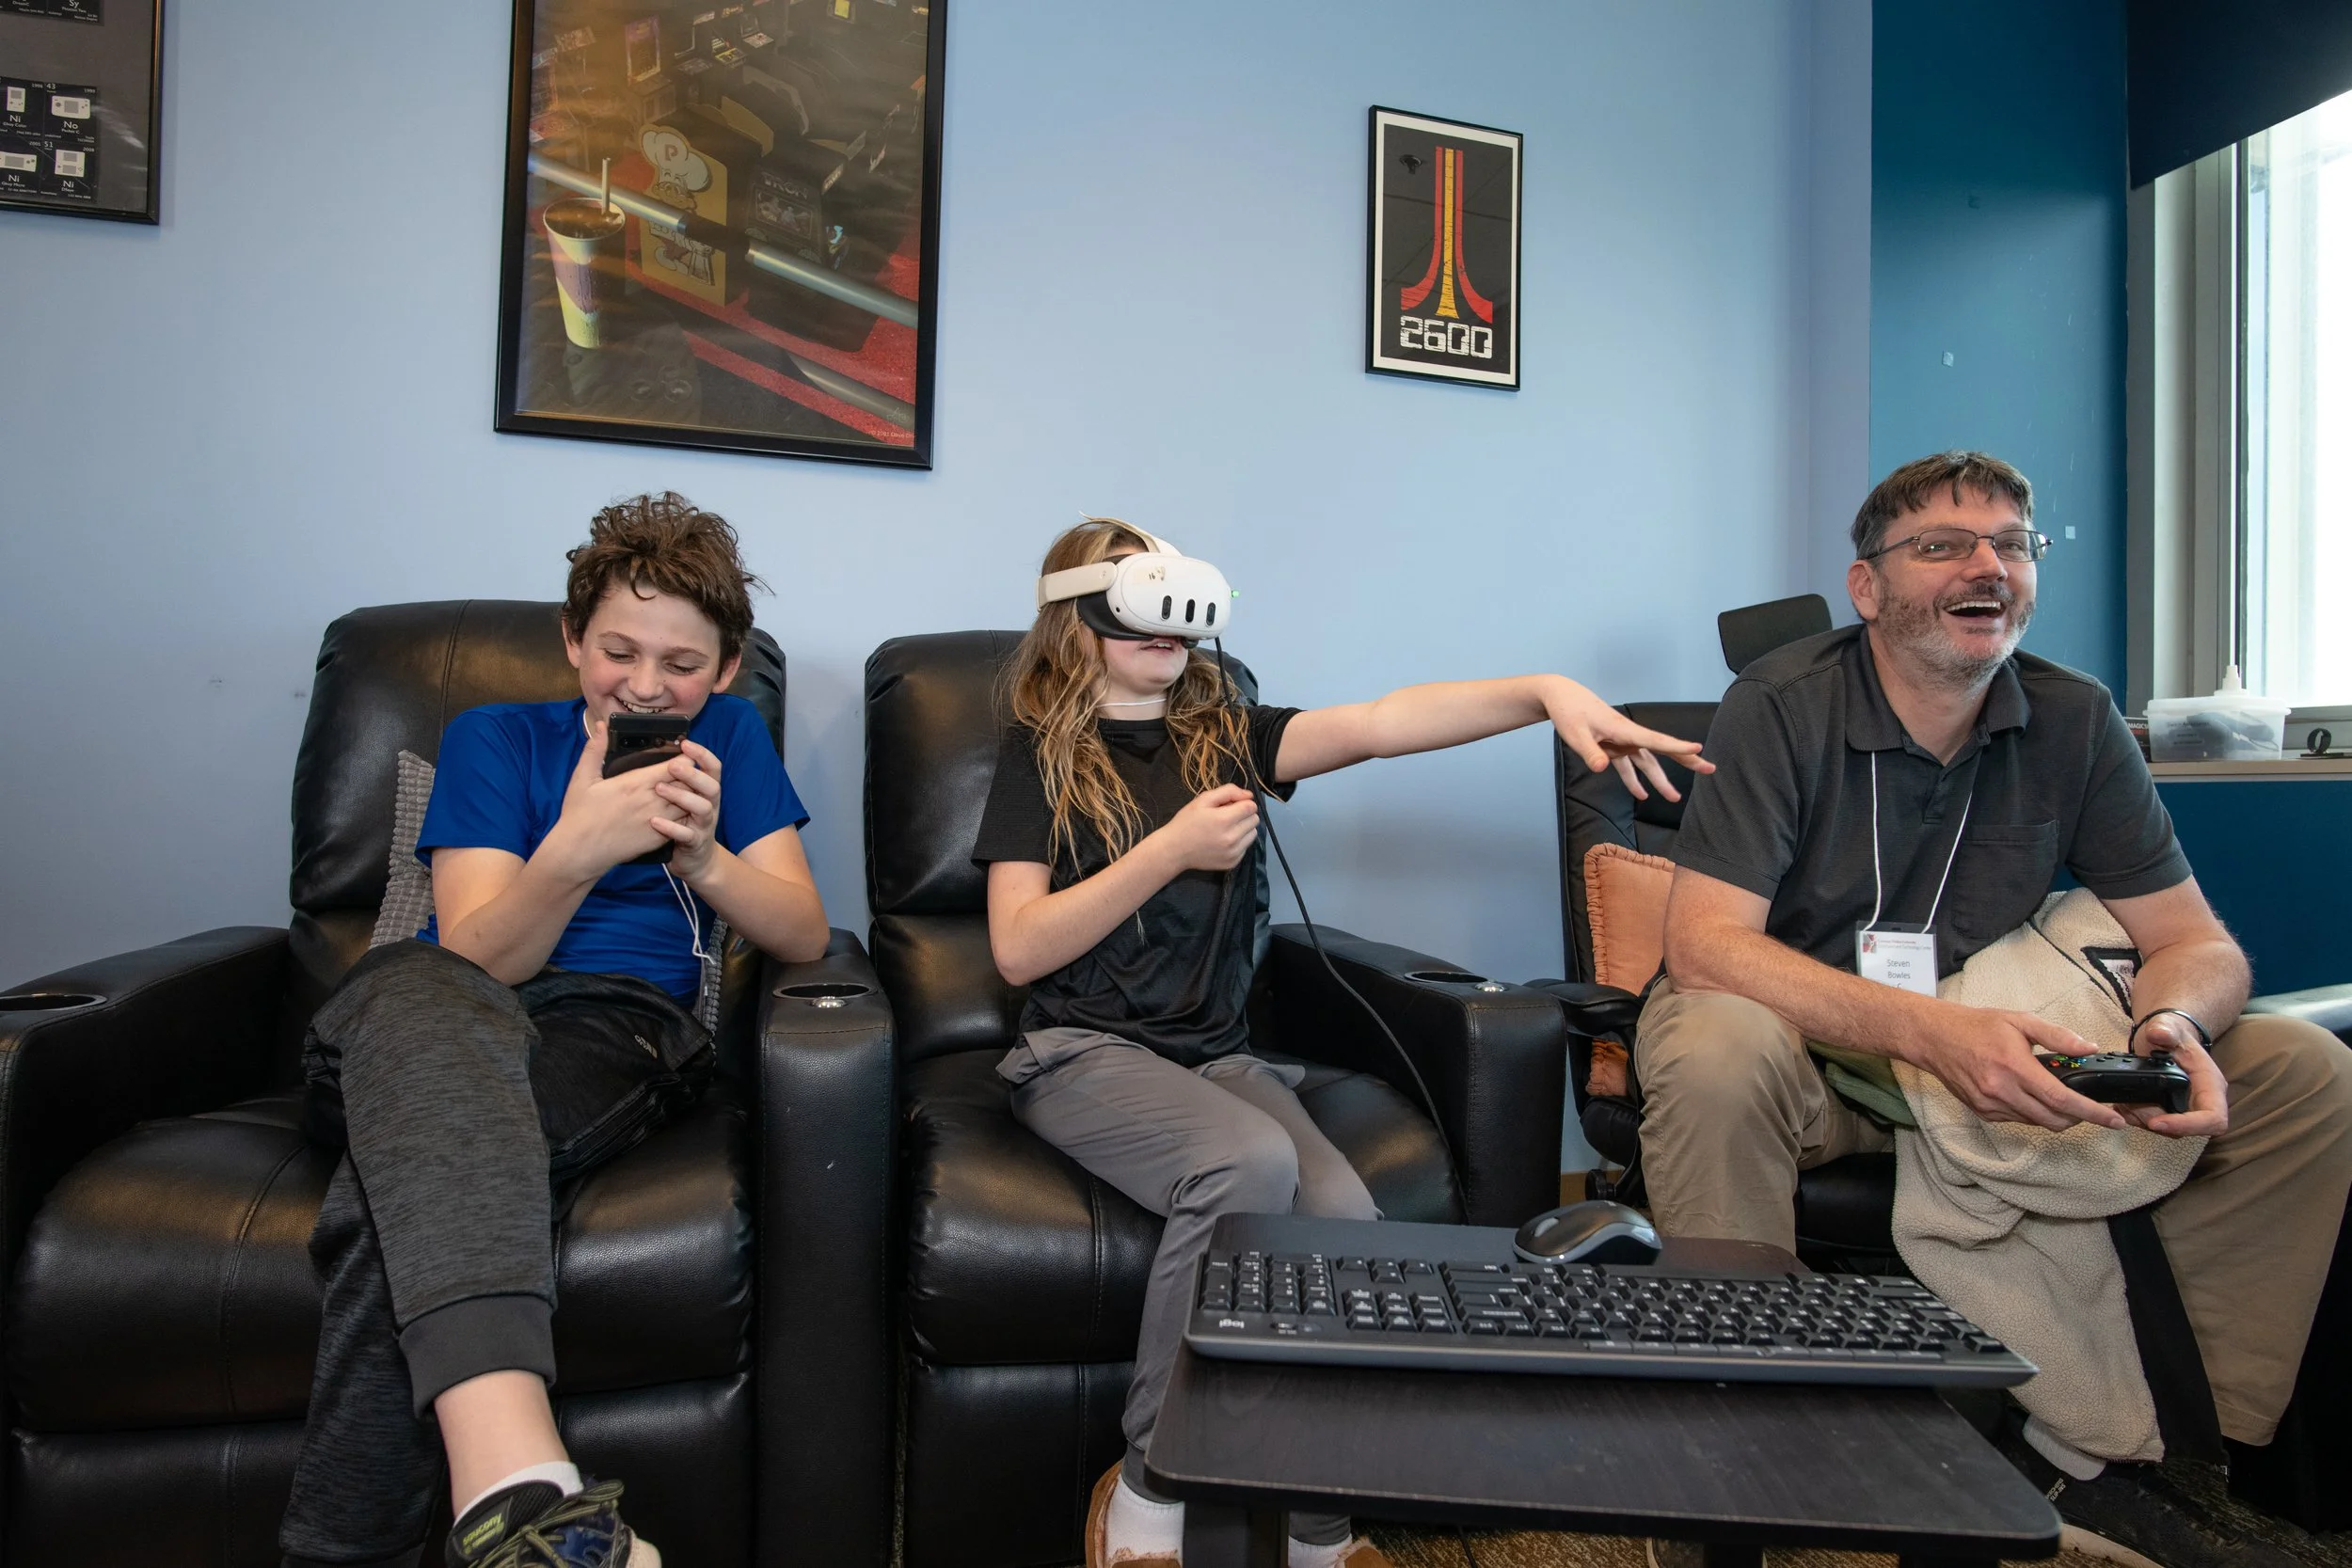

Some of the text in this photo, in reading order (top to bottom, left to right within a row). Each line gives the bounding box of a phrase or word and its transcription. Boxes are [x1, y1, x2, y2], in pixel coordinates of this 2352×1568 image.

[9, 114, 21, 122] Ni
[63, 120, 79, 130] No
[664, 143, 678, 162] P
[8, 174, 20, 182] Ni
[63, 180, 74, 188] Ni
[1400, 315, 1493, 359] 2600
[1148, 572, 1156, 580] 16
[1886, 958, 1911, 968] Steven
[1887, 971, 1911, 979] Bowles
